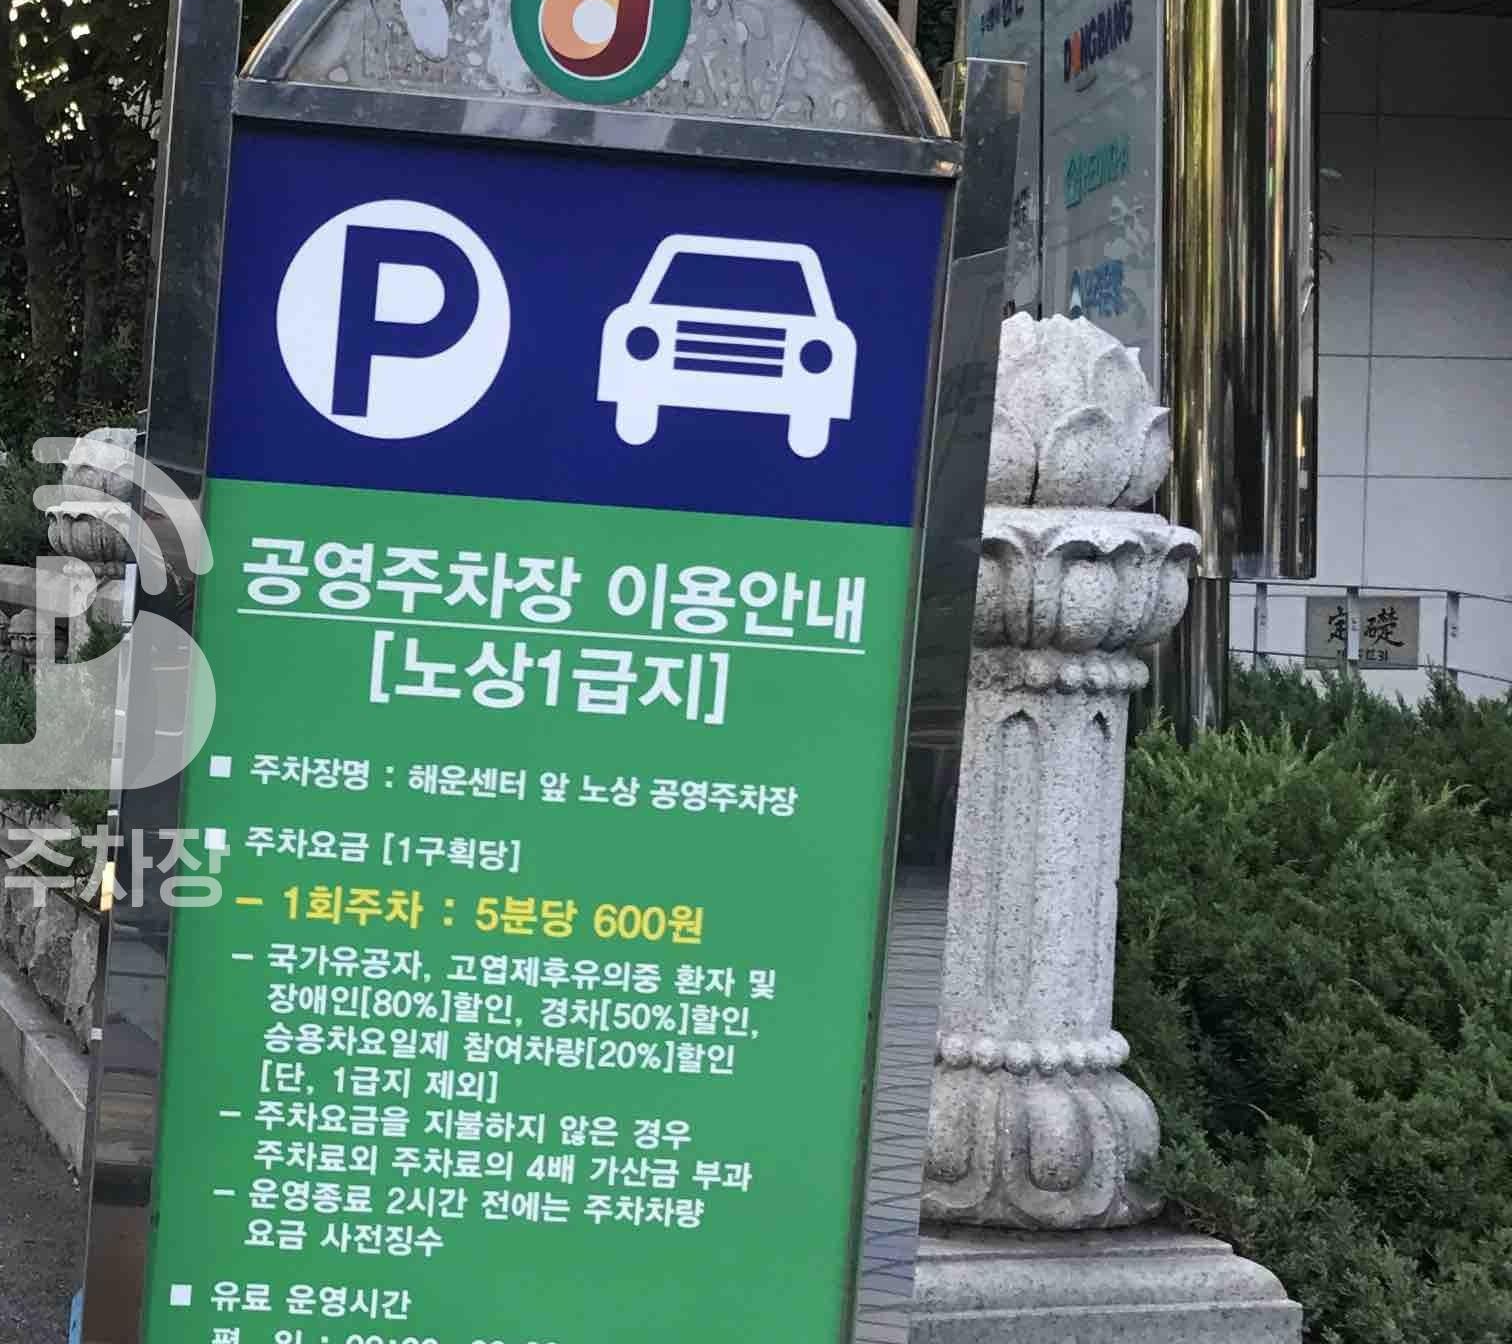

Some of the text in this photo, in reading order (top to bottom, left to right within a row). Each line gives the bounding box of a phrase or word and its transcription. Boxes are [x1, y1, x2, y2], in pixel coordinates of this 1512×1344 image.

[331, 225, 480, 417] P
[244, 538, 865, 643] 공영주차장 이용안내
[251, 755, 369, 790] 주차장명
[409, 765, 525, 800] 해운센터
[541, 773, 569, 802] 앞
[579, 776, 640, 806] 노상
[650, 779, 798, 816] 공영주차장
[246, 827, 369, 862] 주차요금
[285, 886, 423, 928] 1회주차
[476, 896, 577, 937] 5분당
[594, 904, 702, 944] 600원
[268, 944, 430, 982] 국가유공자,
[675, 965, 735, 997] 환자
[750, 970, 775, 999] 및
[264, 1022, 448, 1060] 승용차요일제
[334, 1067, 410, 1098] 1급지
[255, 1101, 691, 1149] 주차요금을 지불하지 않은 경우
[392, 1148, 513, 1181] 주차료의
[527, 1155, 574, 1184] 4배
[590, 1156, 679, 1188] 가산금
[693, 1161, 752, 1191] 부과
[249, 1179, 704, 1228] 운영종료 2시간 전에는 주차차량
[245, 1219, 443, 1256] 요금 사전징수
[211, 1282, 411, 1319] 유료 운영시간
